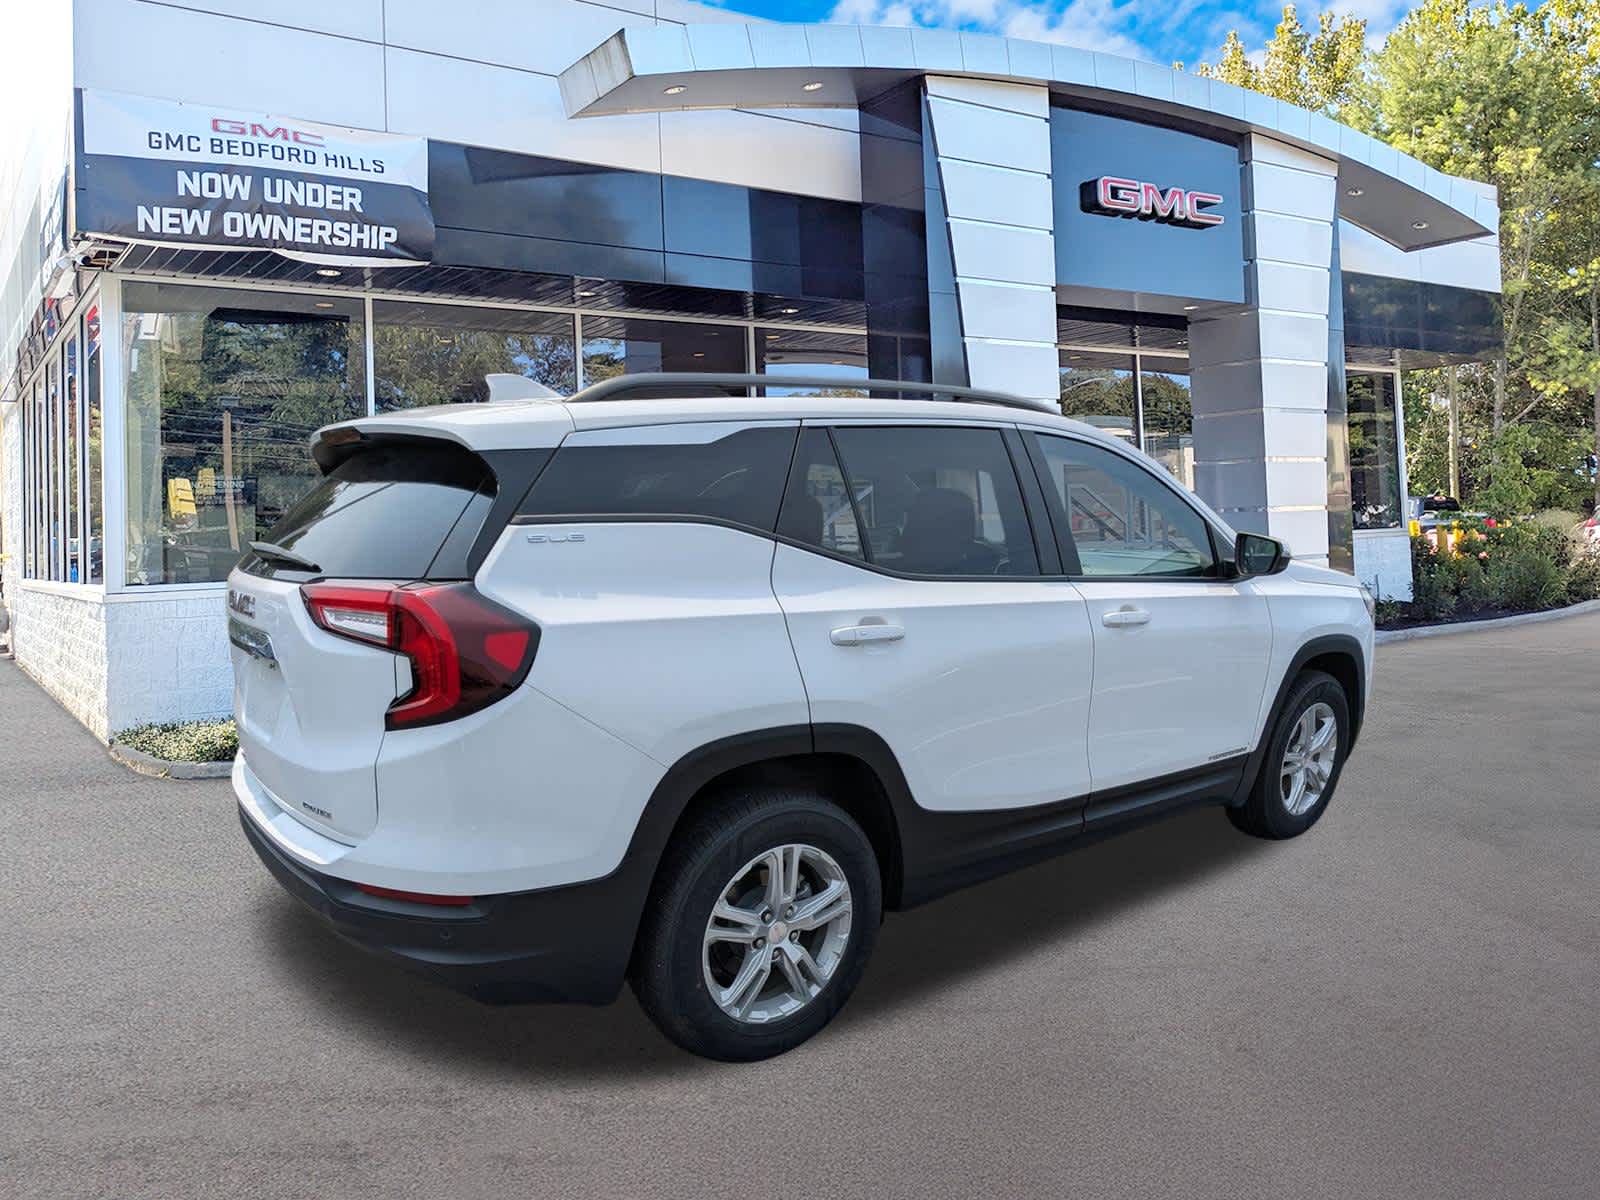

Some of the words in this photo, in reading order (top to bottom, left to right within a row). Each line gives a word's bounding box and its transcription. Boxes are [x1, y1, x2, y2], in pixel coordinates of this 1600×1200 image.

[148, 131, 201, 153] GMC
[210, 138, 317, 165] BEDFORD
[324, 152, 385, 174] HILLS
[211, 118, 326, 148] GMC
[177, 170, 252, 201] NOW
[263, 177, 364, 213] UNDER
[1097, 175, 1225, 225] GMC
[137, 205, 211, 236] NEW
[223, 211, 398, 250] OWNERSHIP
